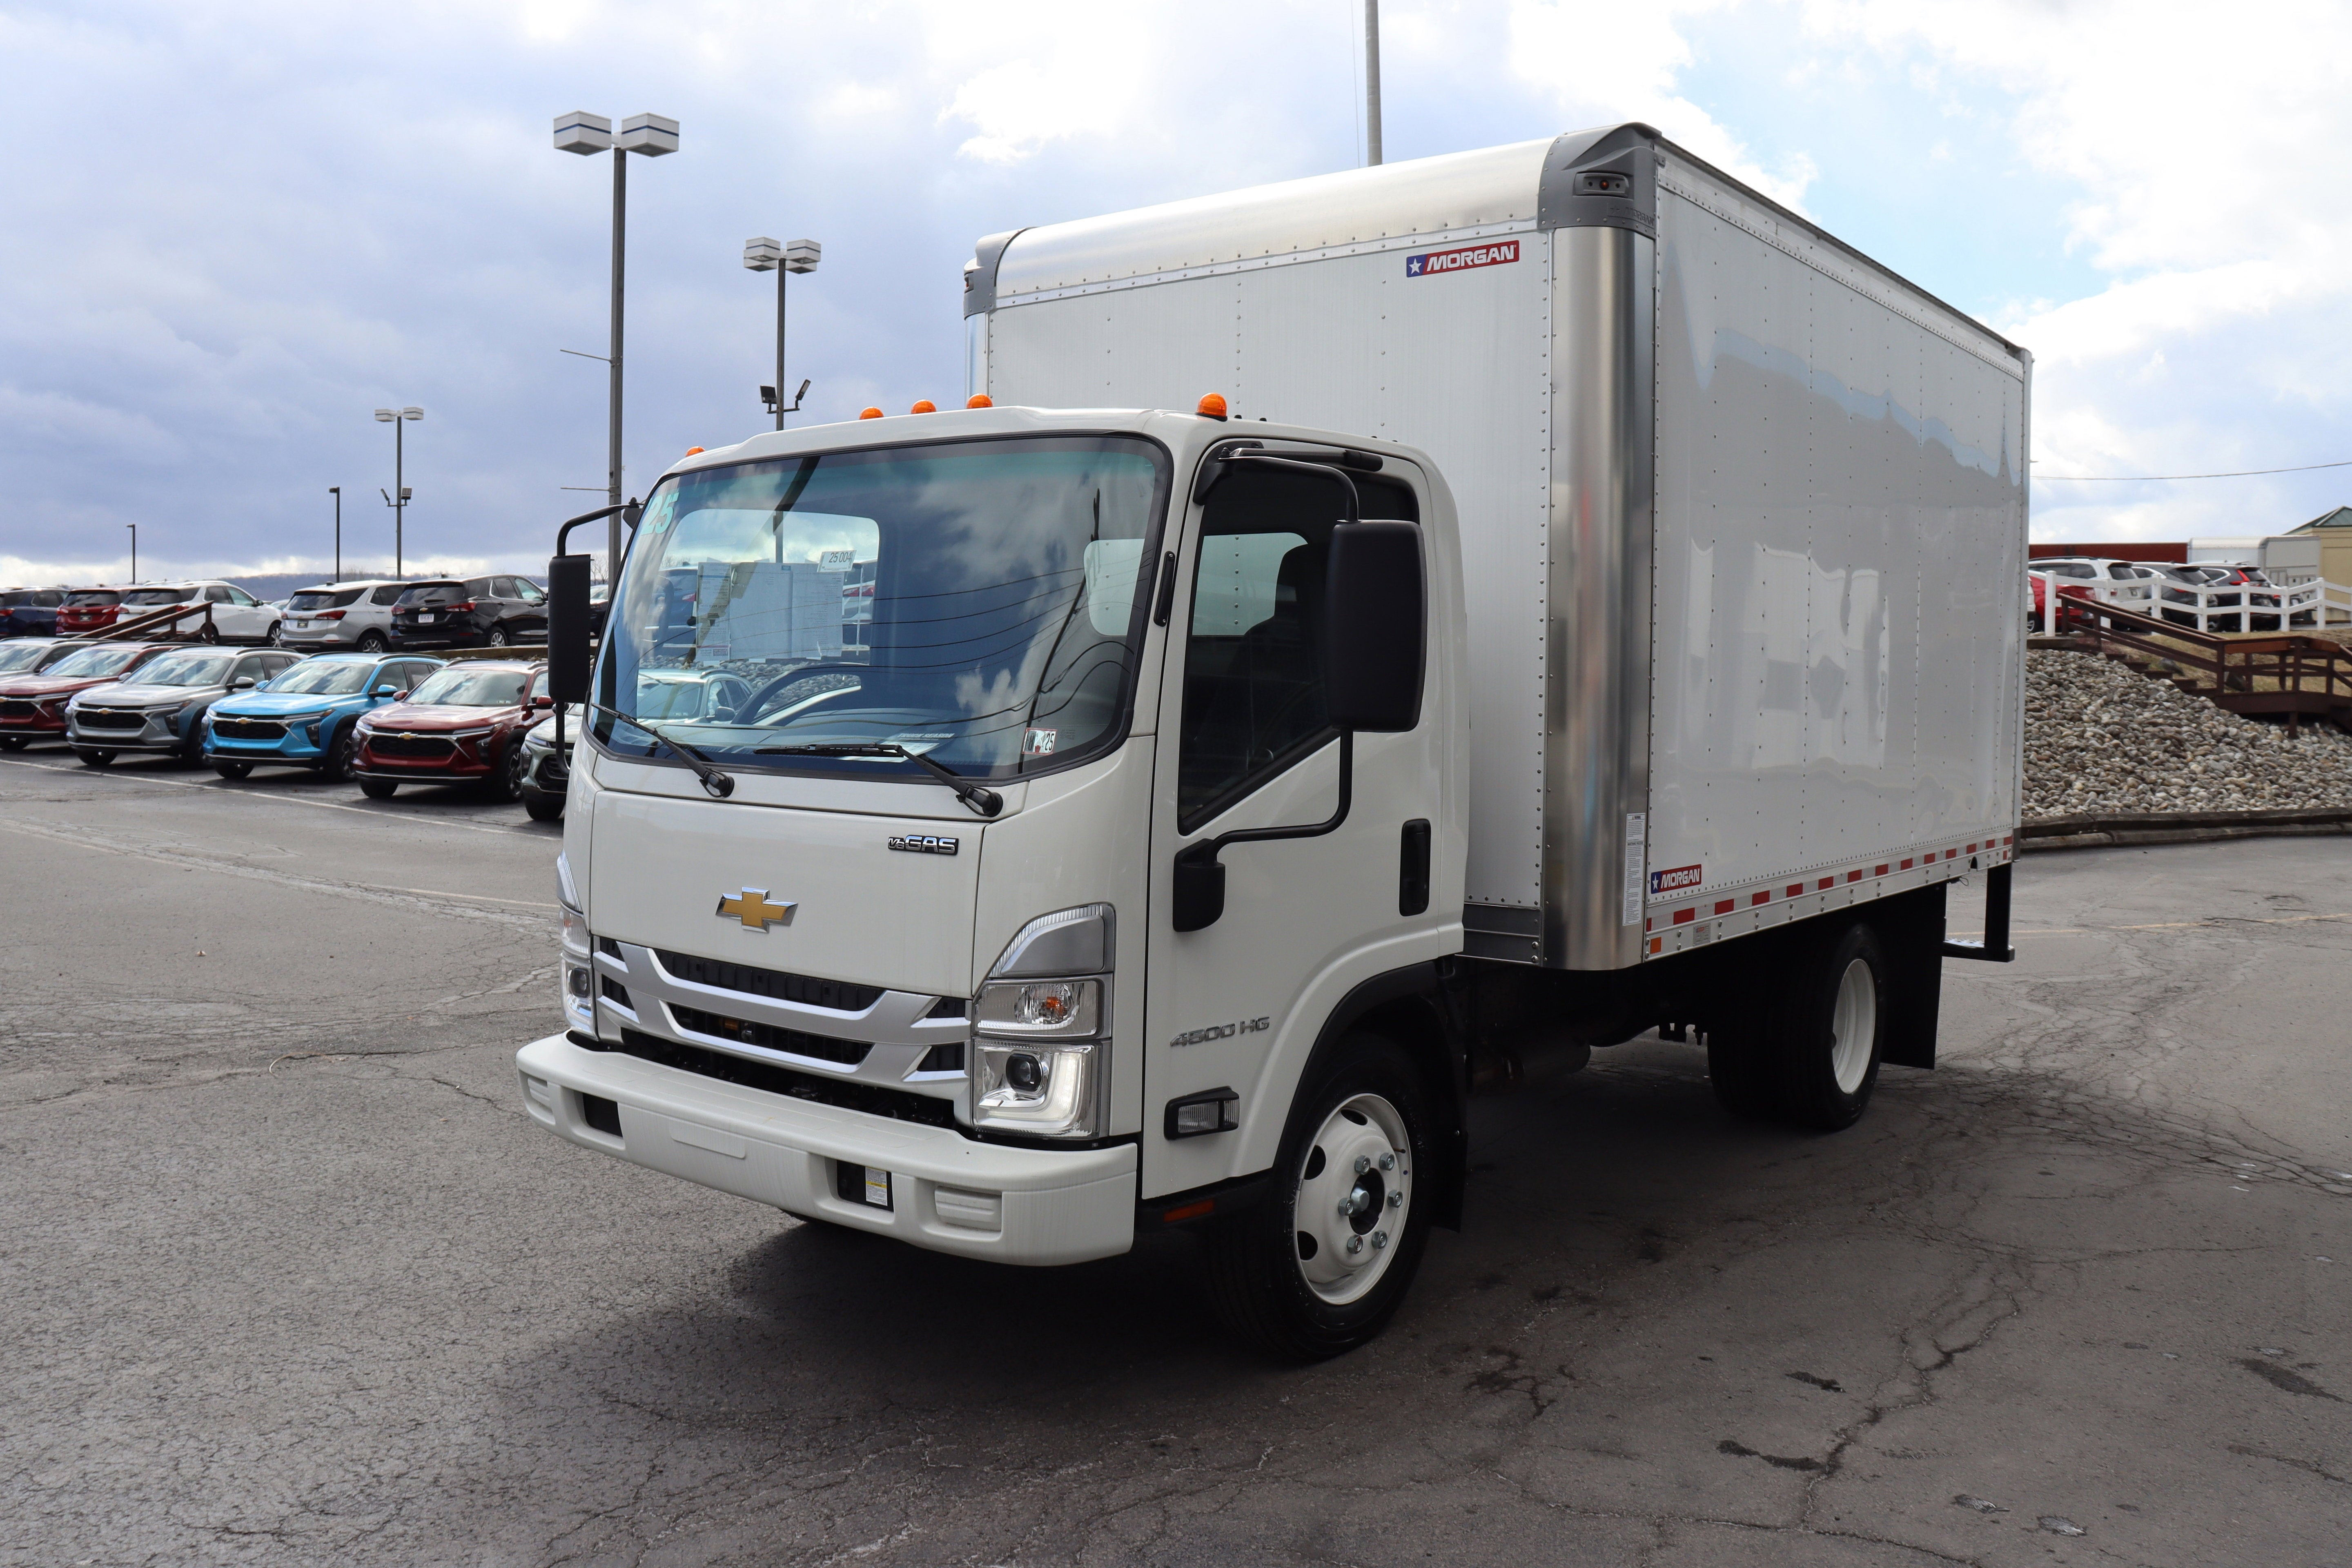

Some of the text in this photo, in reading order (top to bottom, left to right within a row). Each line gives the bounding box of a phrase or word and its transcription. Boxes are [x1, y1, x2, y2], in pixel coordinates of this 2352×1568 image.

[1426, 244, 1515, 272] MORGAN
[640, 492, 679, 536] 25
[1045, 733, 1055, 751] 25
[905, 835, 956, 854] GAS
[1660, 868, 1700, 889] MORGAN
[1170, 1016, 1270, 1047] 4500 HG
